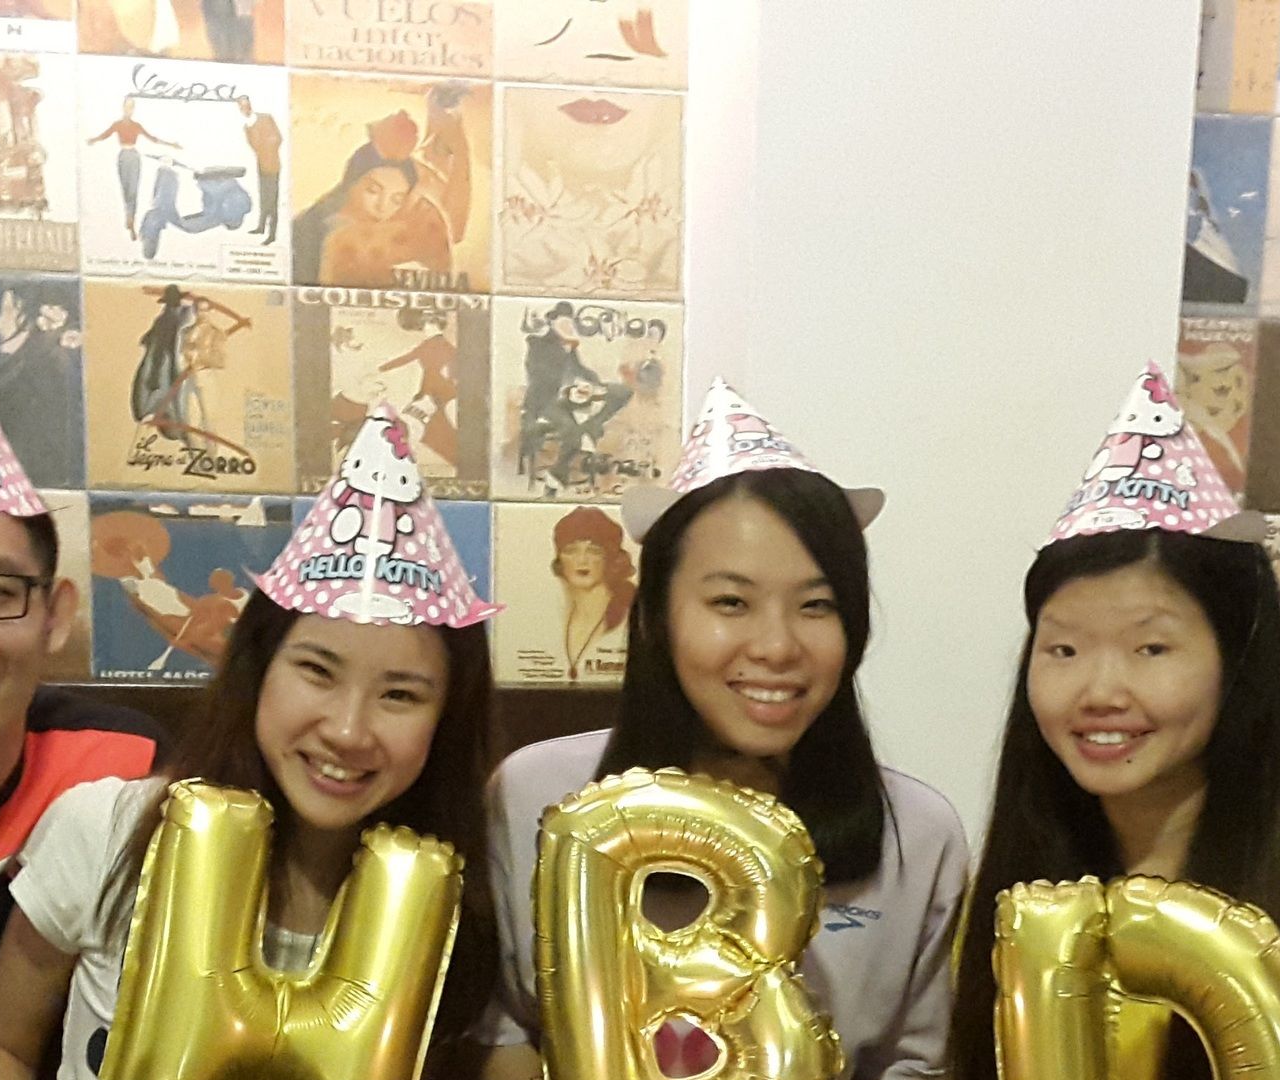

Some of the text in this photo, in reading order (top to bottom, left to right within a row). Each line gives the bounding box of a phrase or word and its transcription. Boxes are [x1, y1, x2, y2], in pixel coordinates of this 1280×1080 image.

[297, 287, 490, 312] COLISEUM
[178, 447, 257, 480] ZORRO
[1114, 475, 1190, 511] KITTY
[298, 552, 442, 595] HELLO KITTY
